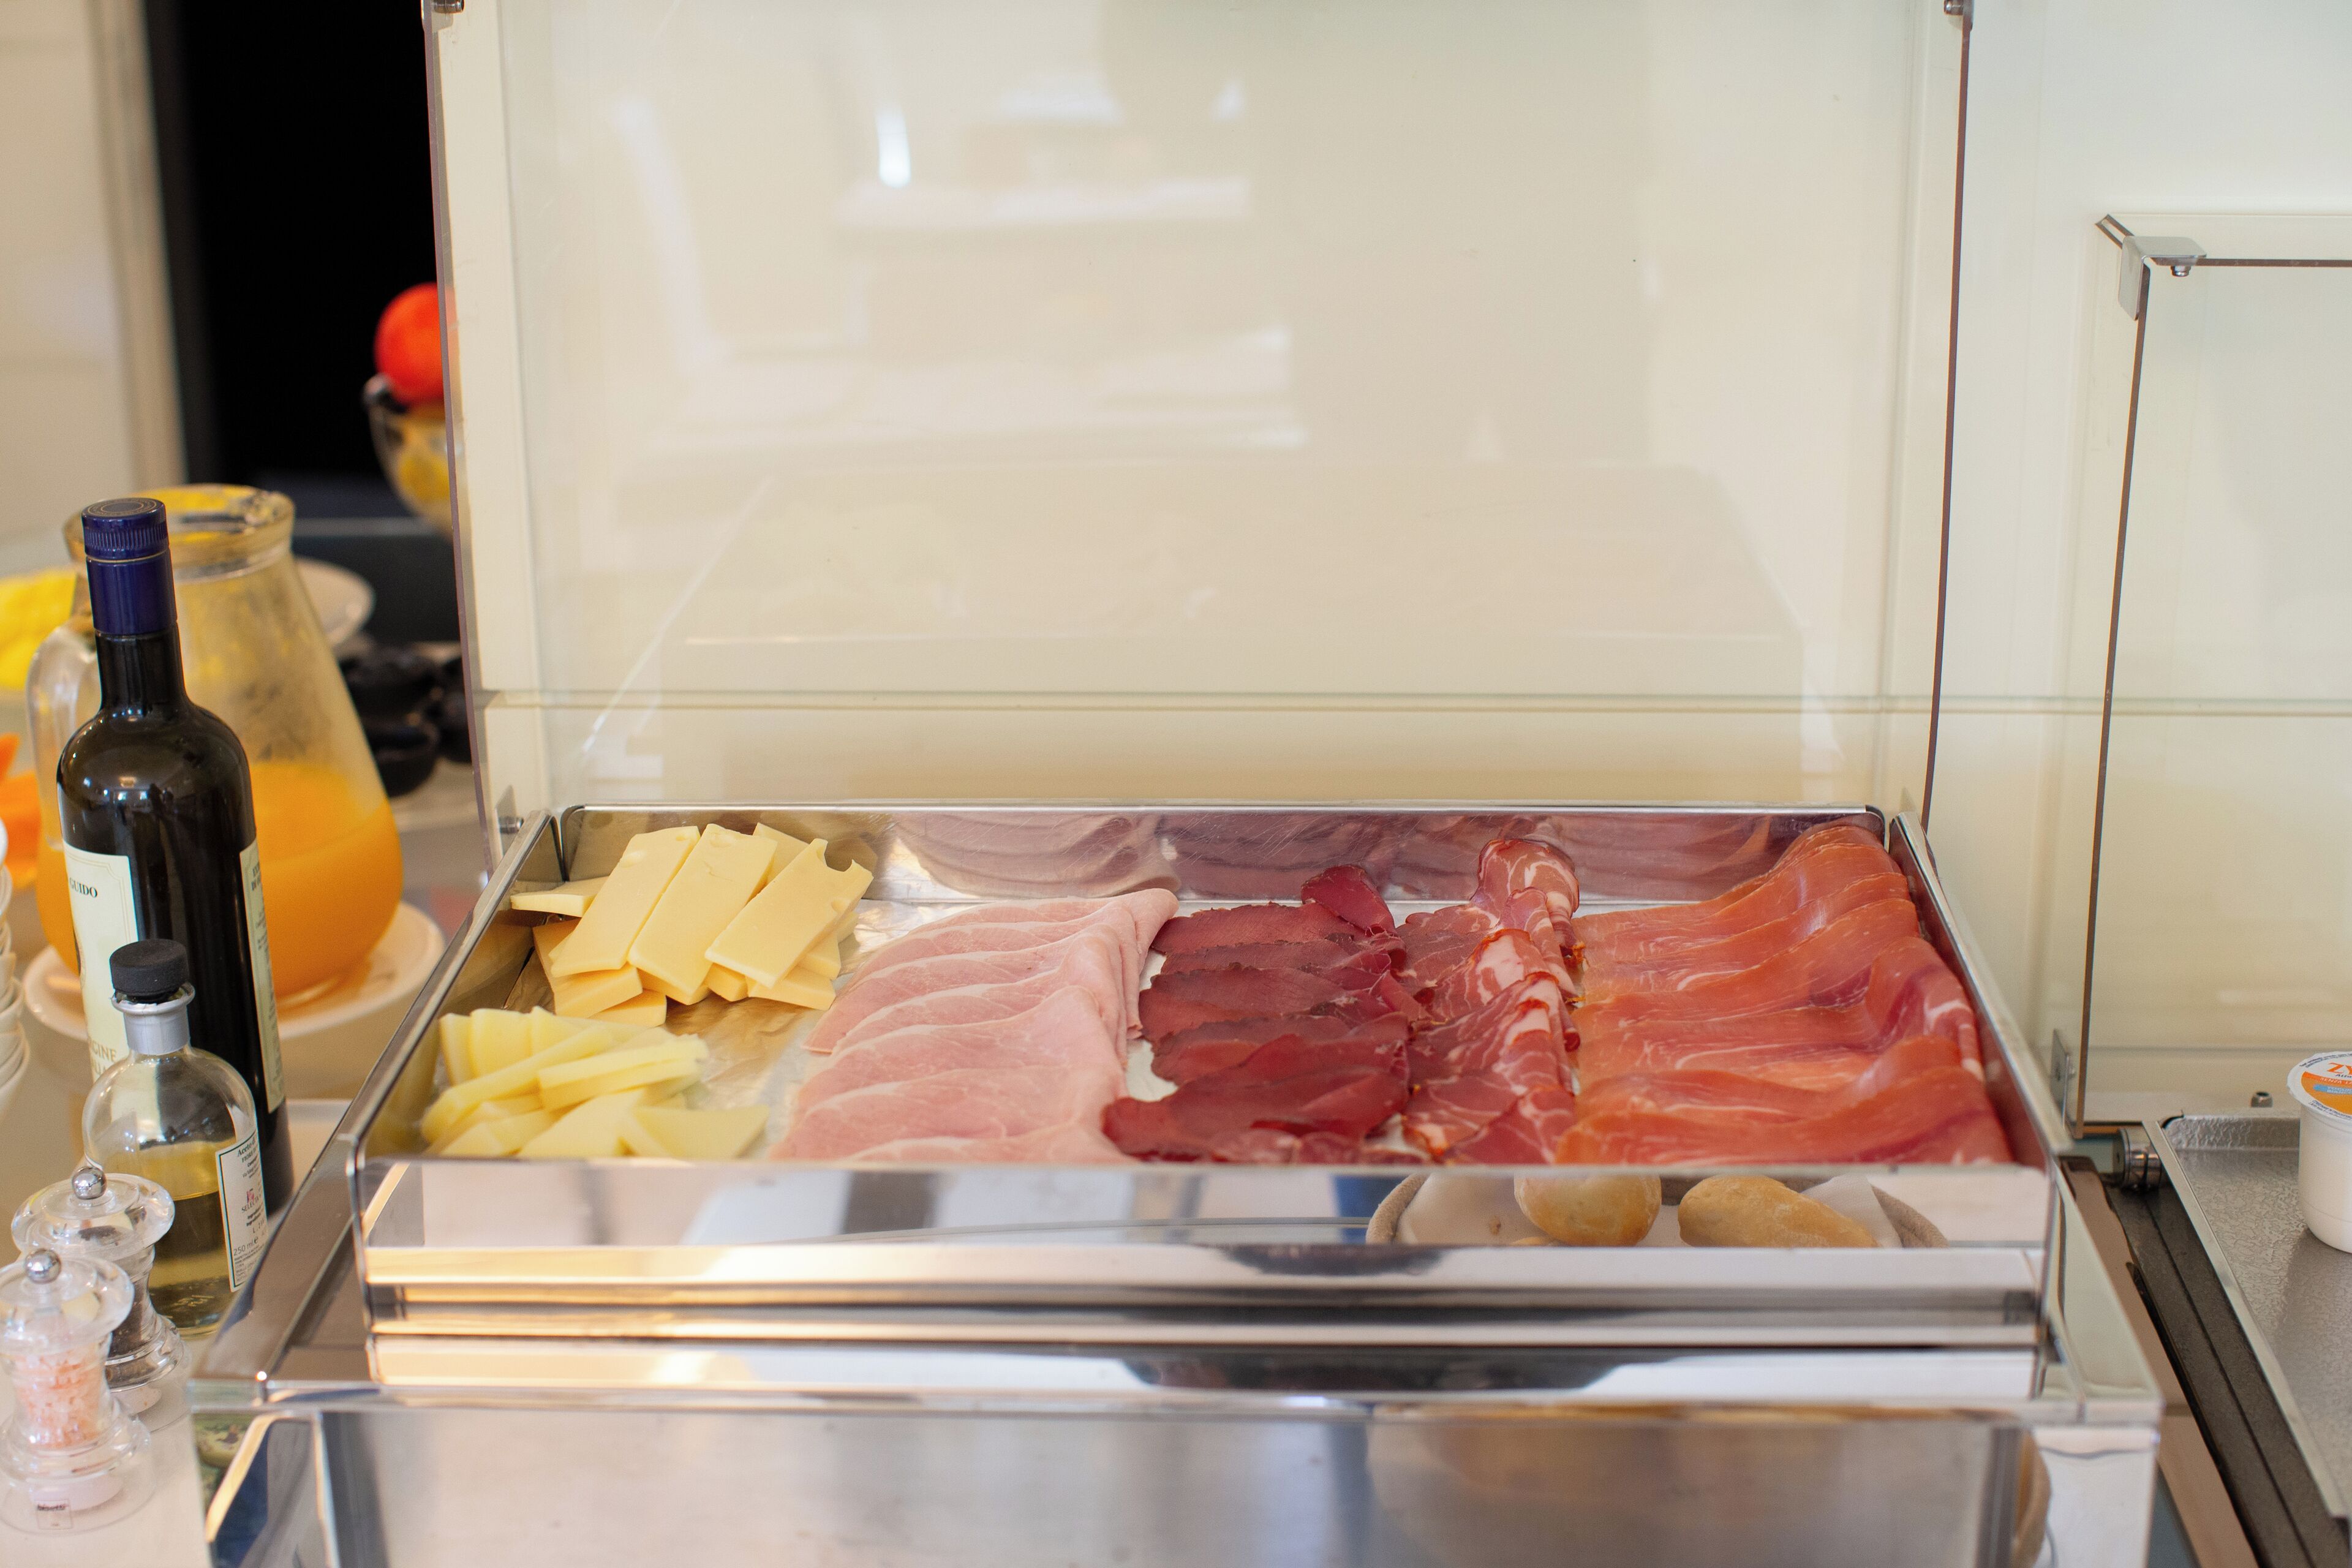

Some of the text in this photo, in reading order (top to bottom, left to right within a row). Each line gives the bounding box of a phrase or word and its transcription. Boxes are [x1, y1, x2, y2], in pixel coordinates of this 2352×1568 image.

[69, 877, 97, 898] GUIDO
[238, 1143, 252, 1157] Aceto
[233, 1245, 246, 1256] 250
